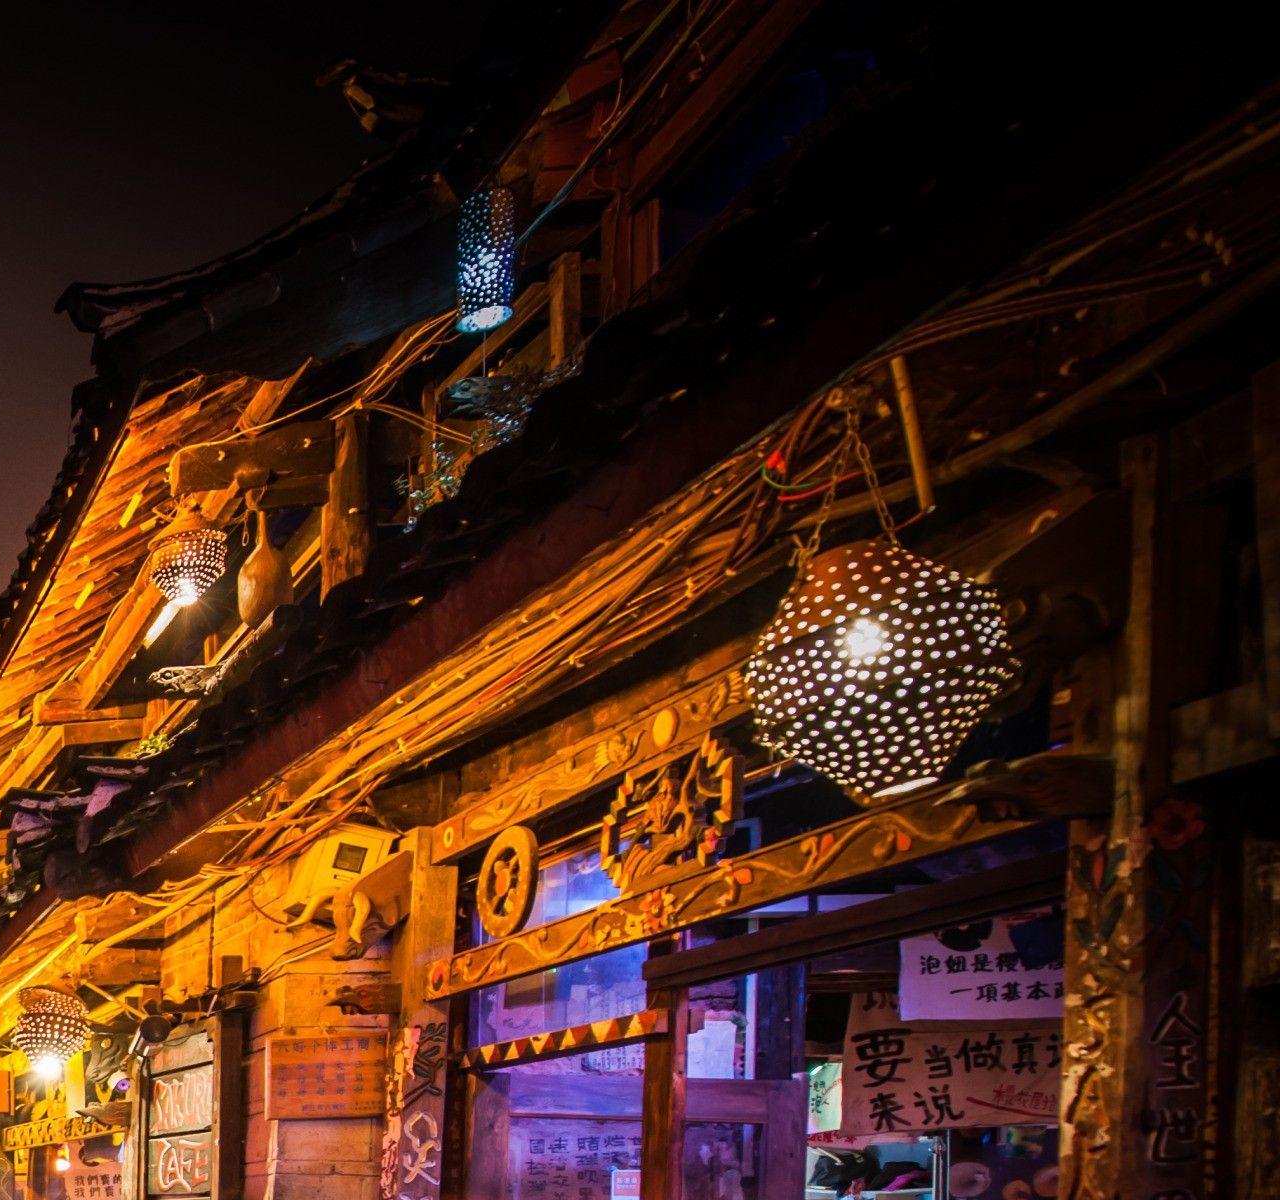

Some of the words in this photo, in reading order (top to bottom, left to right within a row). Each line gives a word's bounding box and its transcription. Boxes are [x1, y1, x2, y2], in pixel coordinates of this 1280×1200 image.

[919, 952, 1064, 976] 泡妞是櫻
[868, 1083, 965, 1132] 来说
[156, 1138, 209, 1193] CAFE
[74, 1186, 122, 1198] 我們賣
